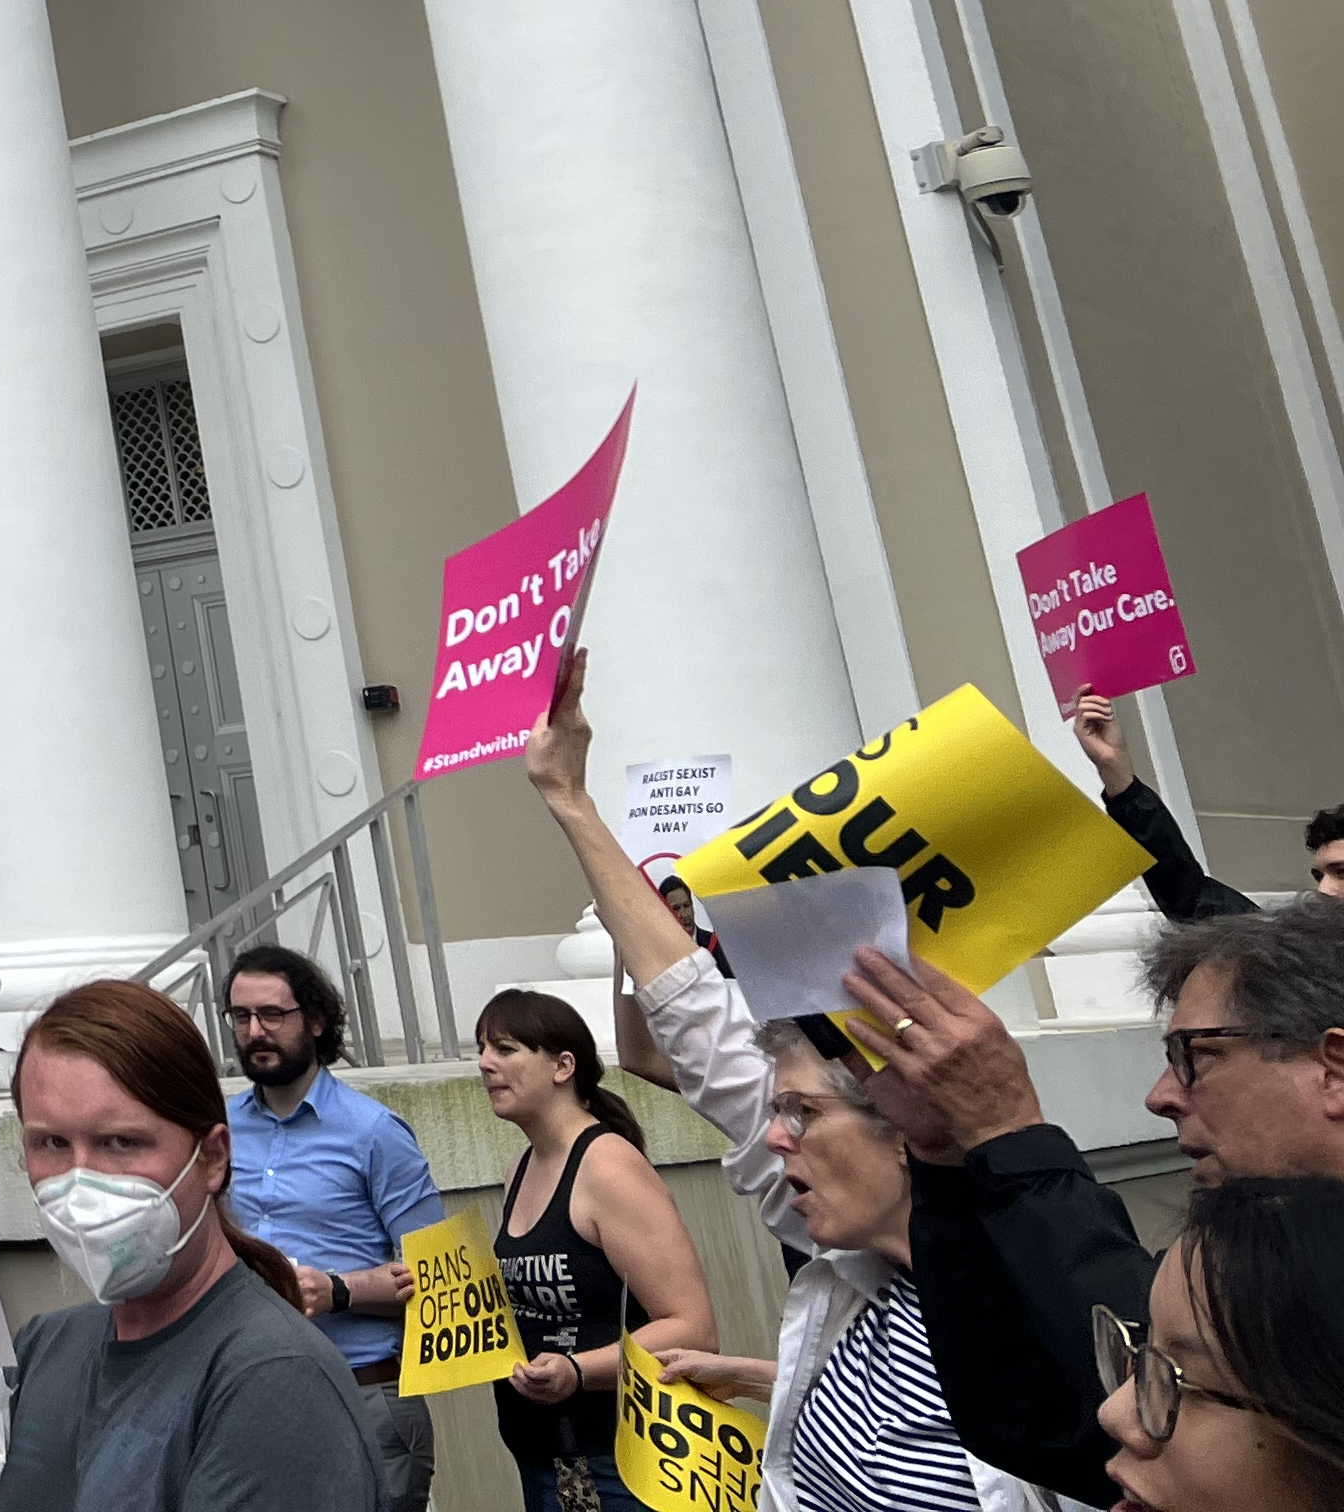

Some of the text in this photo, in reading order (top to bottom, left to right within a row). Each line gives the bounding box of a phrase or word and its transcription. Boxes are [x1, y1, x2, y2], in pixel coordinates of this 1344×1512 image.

[445, 573, 545, 648] Don't
[1029, 561, 1118, 620] Don't Take
[1039, 589, 1176, 658] Away Our Care.
[435, 633, 544, 700] Away
[423, 730, 531, 773] #StandwithP
[642, 766, 716, 785] RACIST SEXIST
[628, 802, 724, 819] RON DESANTIS GO
[649, 785, 701, 799] ANTI GAY
[653, 821, 689, 833] AWAY
[417, 1245, 472, 1293] BANS
[499, 1253, 574, 1283] DUCTIVE
[420, 1287, 461, 1329] OFF
[464, 1273, 507, 1318] OUR
[419, 1313, 510, 1365] BODIES
